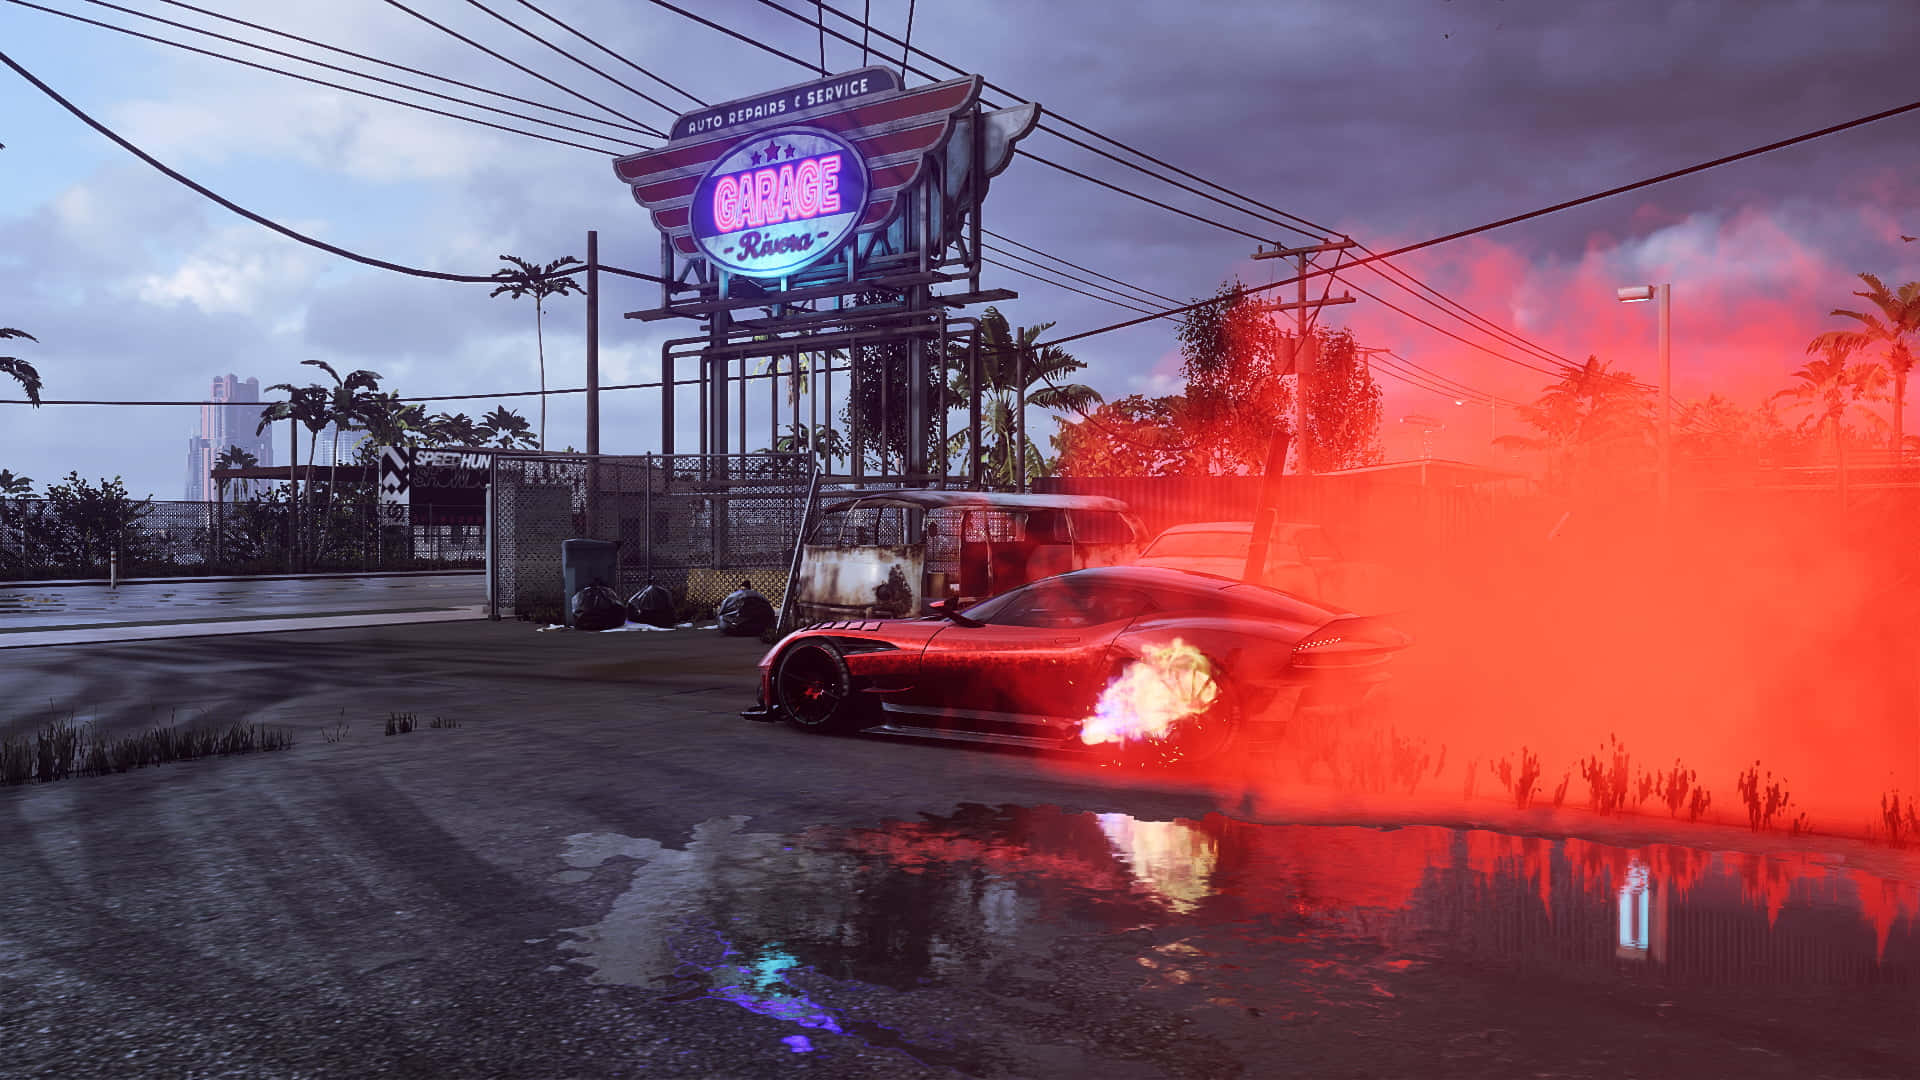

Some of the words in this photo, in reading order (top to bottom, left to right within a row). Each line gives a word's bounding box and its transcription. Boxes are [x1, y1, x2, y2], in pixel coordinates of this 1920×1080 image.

[688, 116, 722, 134] AUTO
[728, 99, 786, 125] REPAIRS
[807, 78, 869, 106] SERVICE
[713, 154, 841, 233] GARAGE
